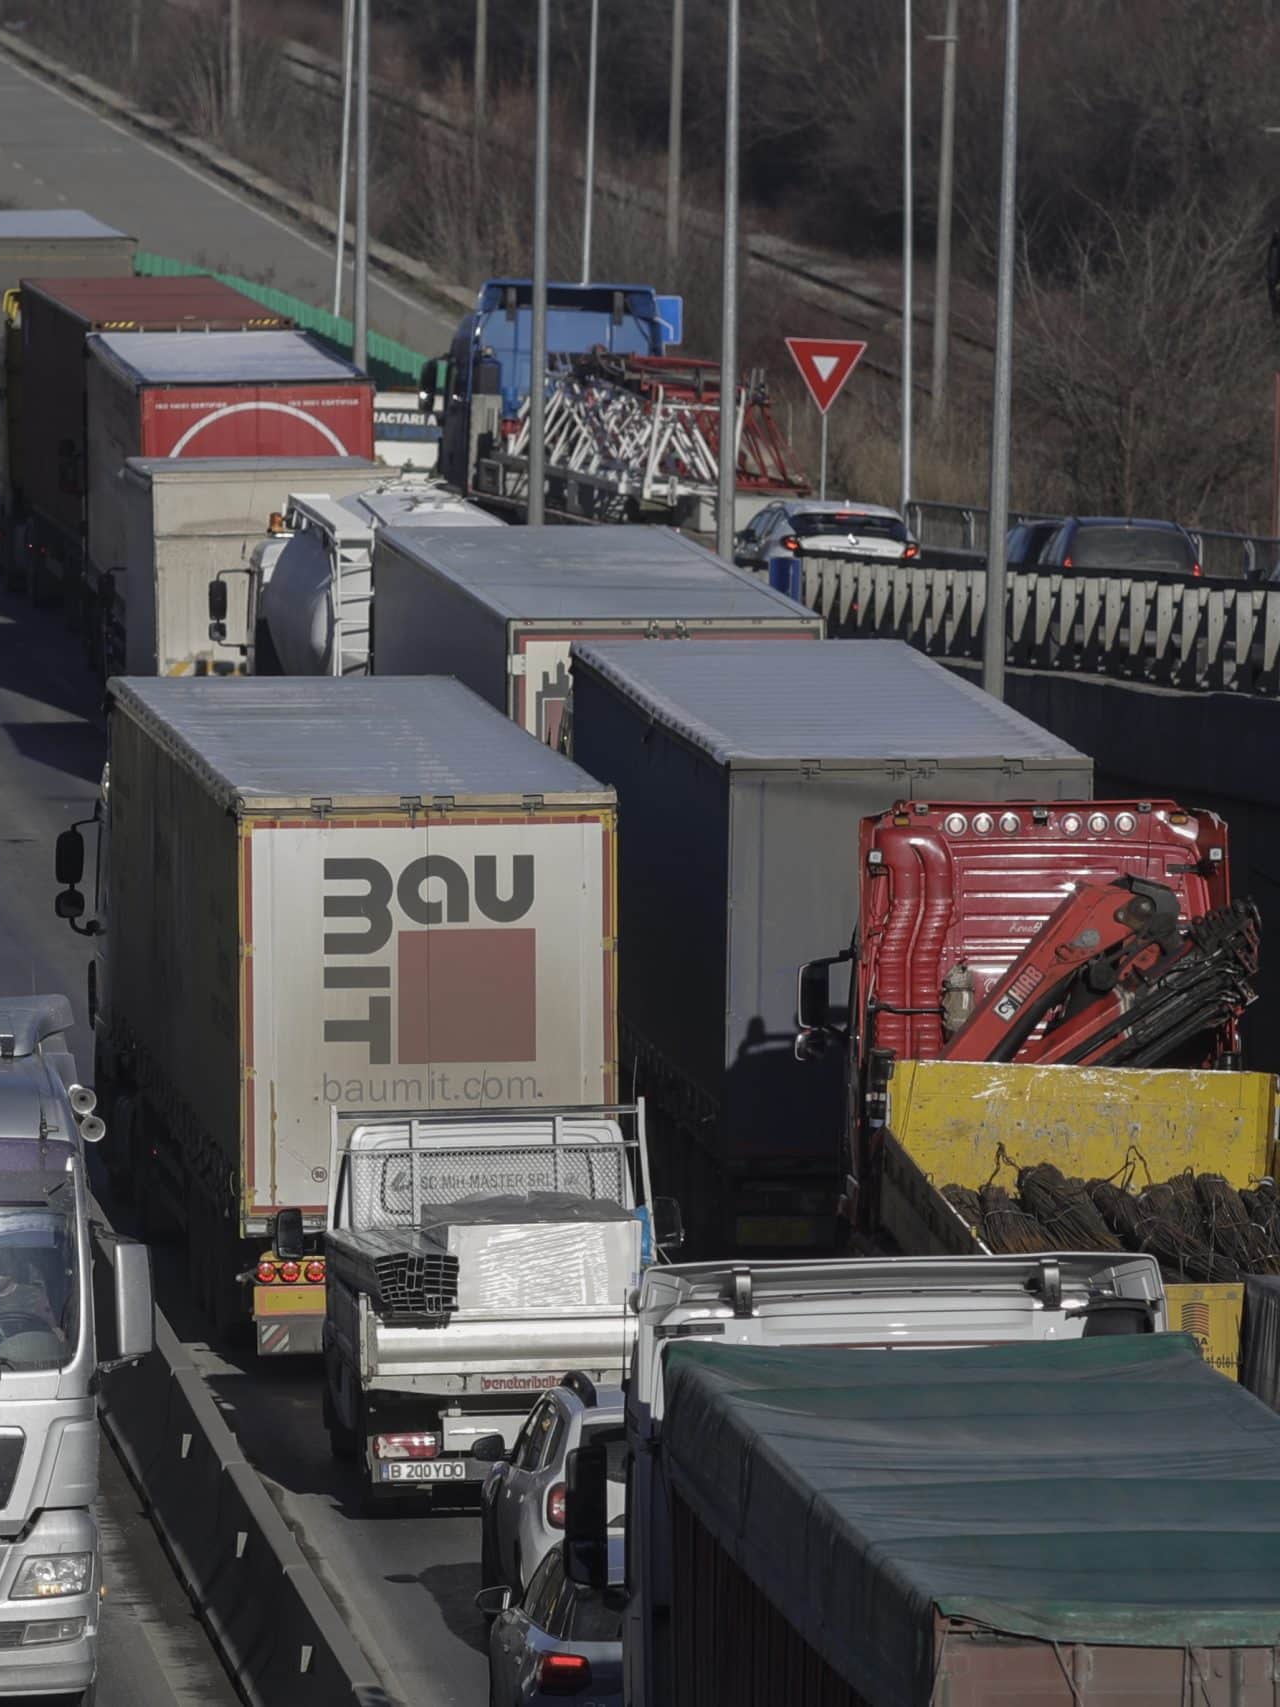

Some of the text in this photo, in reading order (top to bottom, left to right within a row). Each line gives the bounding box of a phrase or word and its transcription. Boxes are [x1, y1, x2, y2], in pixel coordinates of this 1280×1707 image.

[322, 1071, 538, 1103] baumit.com
[390, 1463, 464, 1479] B 200 YDO
